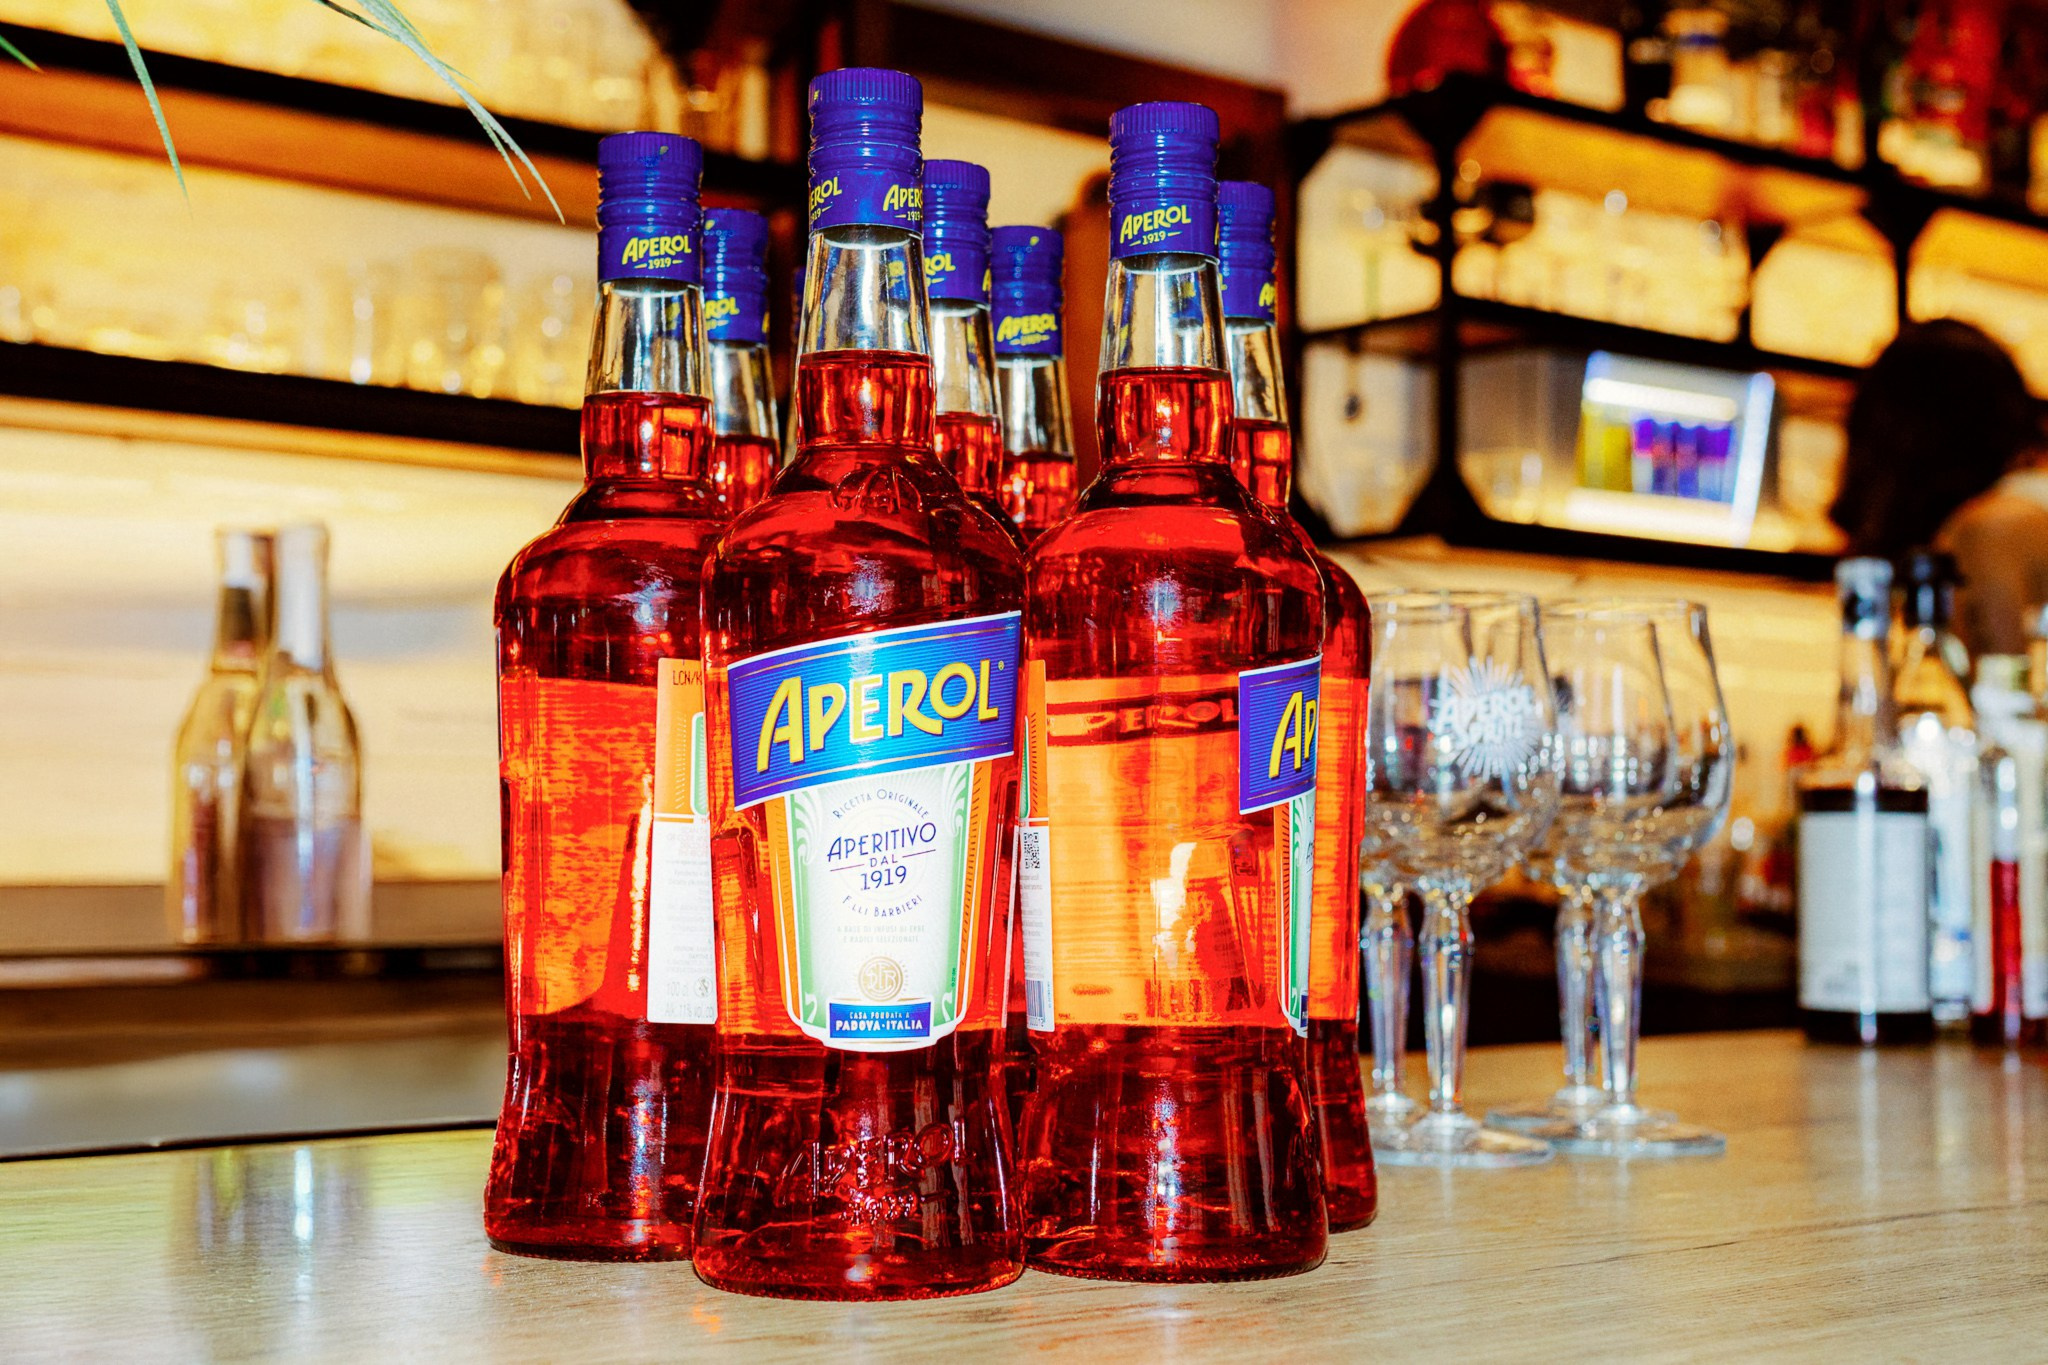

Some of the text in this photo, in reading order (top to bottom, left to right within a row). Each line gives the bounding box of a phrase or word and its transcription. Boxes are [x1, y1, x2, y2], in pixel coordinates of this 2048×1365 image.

[1119, 204, 1192, 244] APEROL
[1142, 230, 1167, 246] 1919
[621, 235, 692, 265] APEROL
[648, 257, 672, 270] 1919
[996, 313, 1059, 343] APEROL
[756, 658, 999, 774] APEROL
[1436, 687, 1536, 734] APEROL
[832, 788, 930, 820] RICETTA ORIGINALE
[827, 822, 937, 863] APERITIVO
[869, 853, 899, 868] DAL
[860, 865, 908, 891] 1919
[873, 894, 923, 918] BARBIERI
[849, 1011, 868, 1020] CASA
